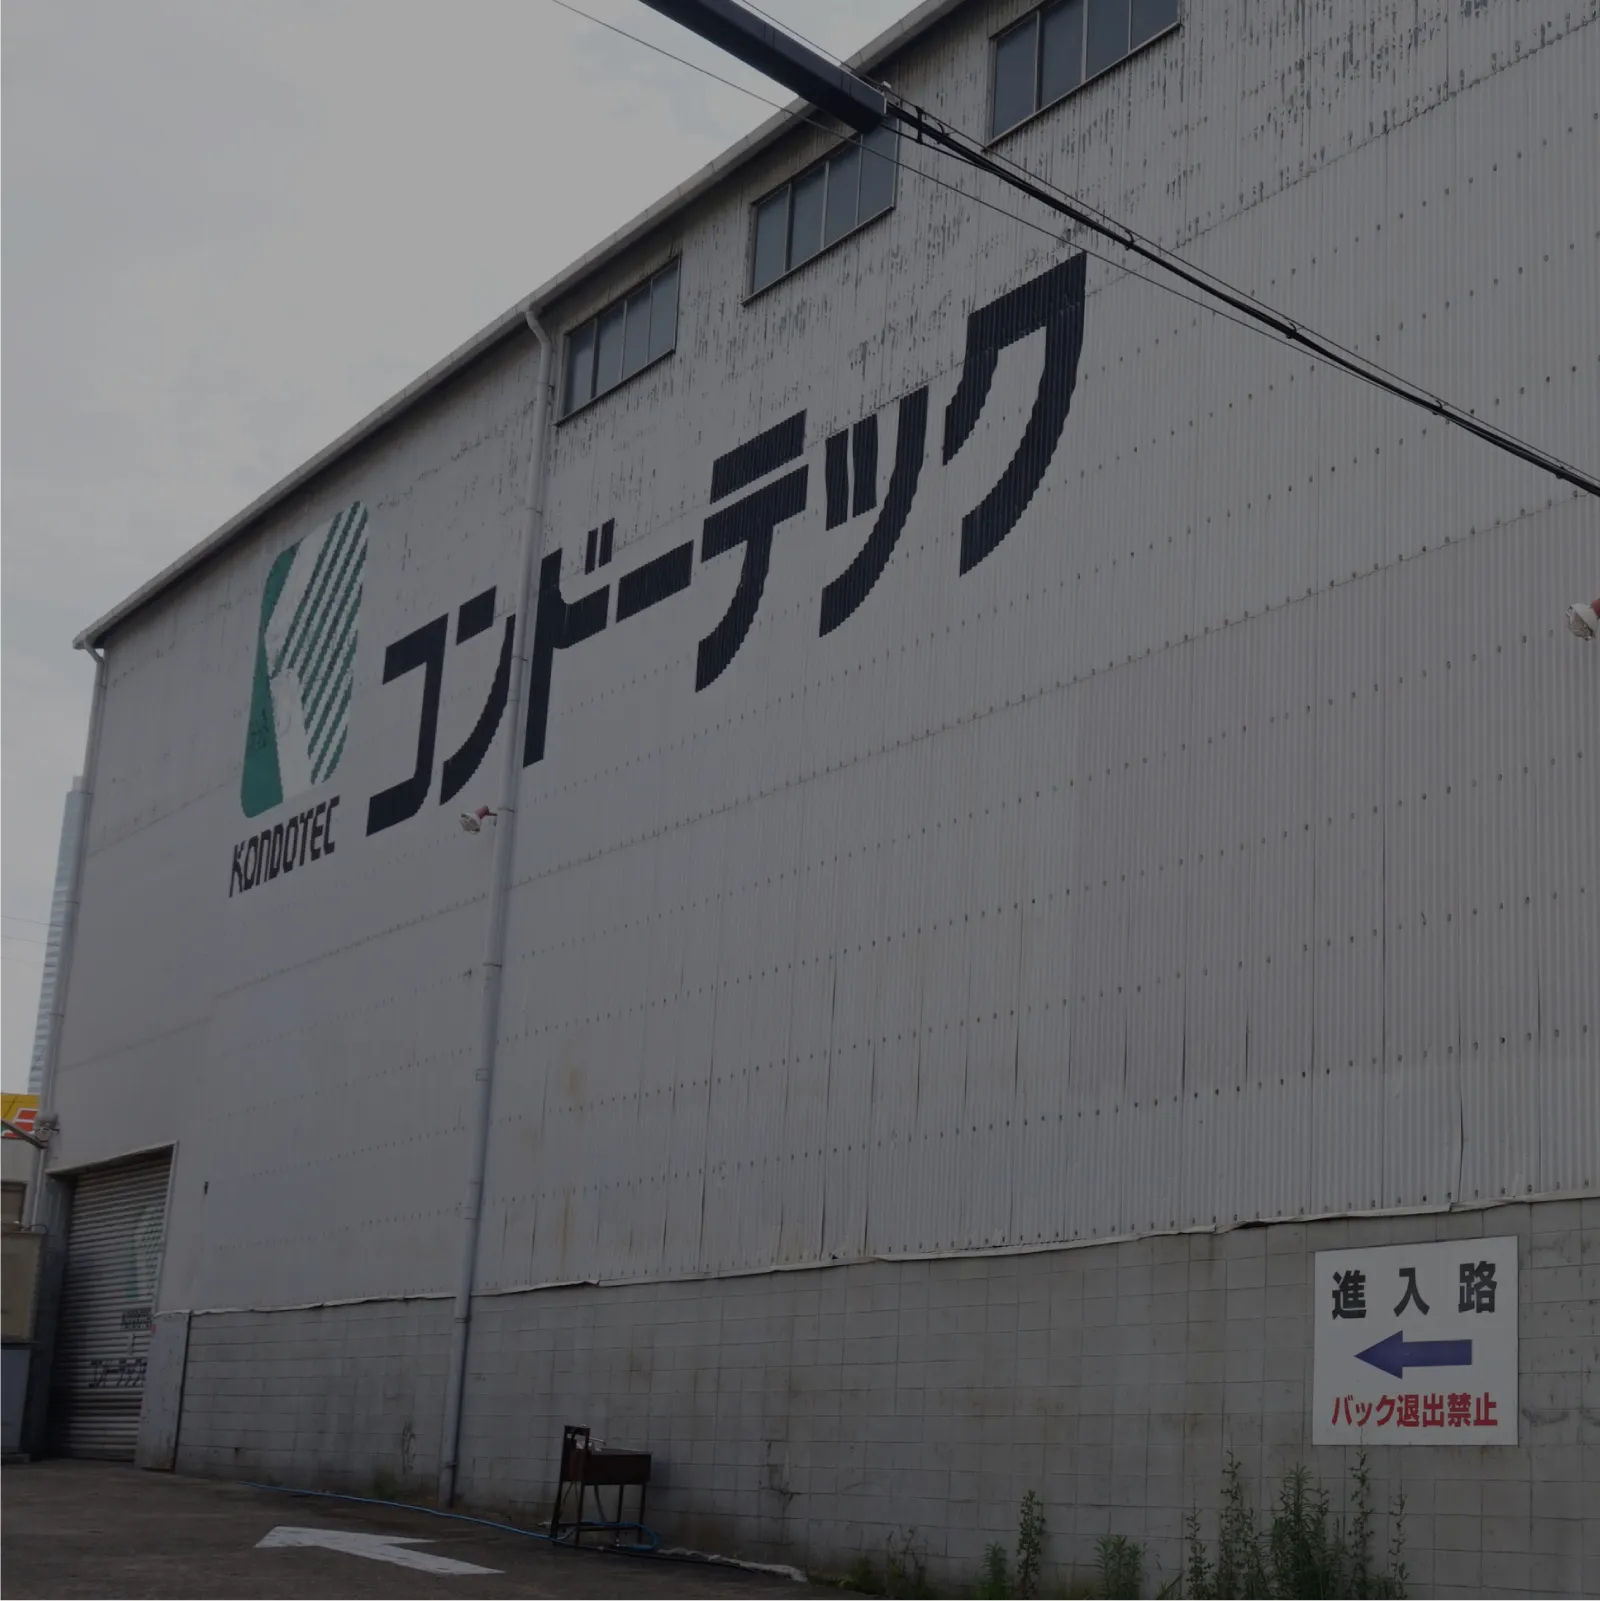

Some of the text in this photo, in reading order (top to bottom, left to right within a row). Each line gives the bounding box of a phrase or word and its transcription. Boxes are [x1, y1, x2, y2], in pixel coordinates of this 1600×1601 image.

[366, 252, 1087, 836] コンドーテック
[229, 796, 340, 897] KONDOTEC
[1331, 1260, 1498, 1320] 進入路
[1331, 1391, 1499, 1428] バック退出禁止
